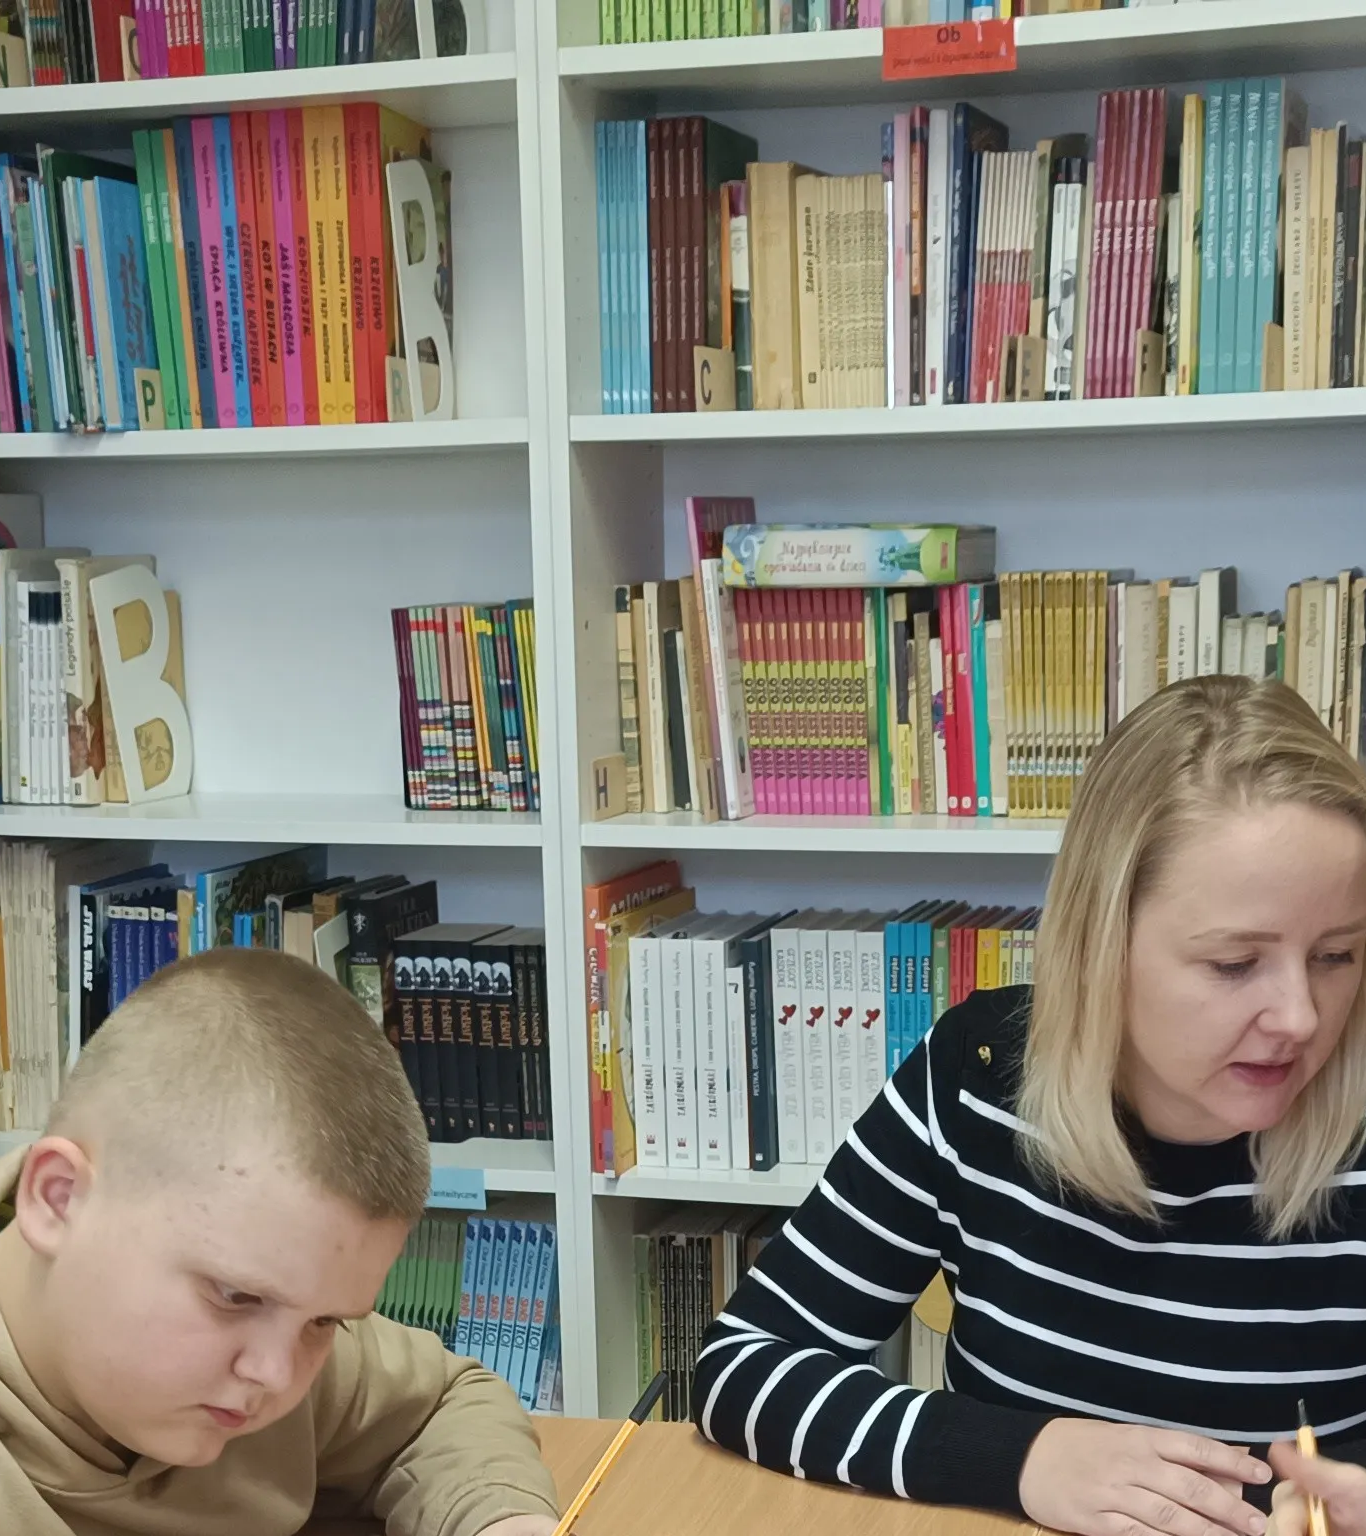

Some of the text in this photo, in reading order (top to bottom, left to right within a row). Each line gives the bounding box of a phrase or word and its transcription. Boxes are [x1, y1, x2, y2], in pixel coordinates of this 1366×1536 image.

[936, 25, 961, 44] Ob
[141, 379, 156, 422] P
[61, 579, 76, 676] Legendy polskie
[595, 767, 609, 811] H
[81, 904, 94, 992] STAR WARS
